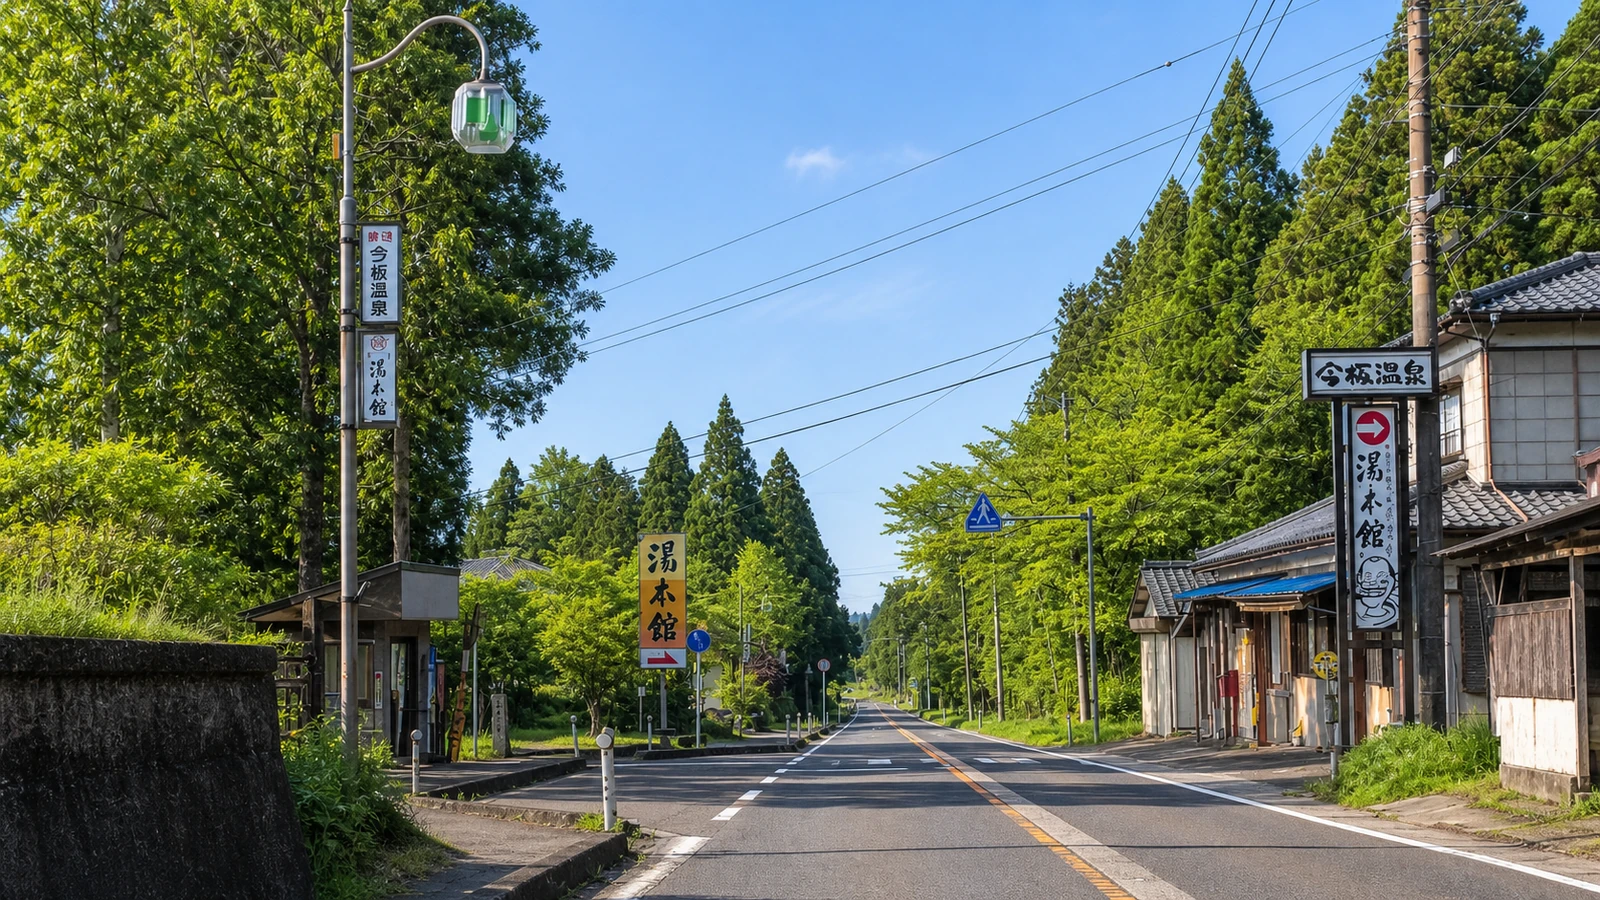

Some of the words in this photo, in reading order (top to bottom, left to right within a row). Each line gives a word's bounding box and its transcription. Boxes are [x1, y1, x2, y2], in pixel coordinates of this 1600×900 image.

[370, 245, 388, 316] 今板温泉
[1315, 359, 1427, 387] 今板温泉
[1355, 451, 1385, 548] 湯本館
[647, 540, 679, 642] 湯本館
